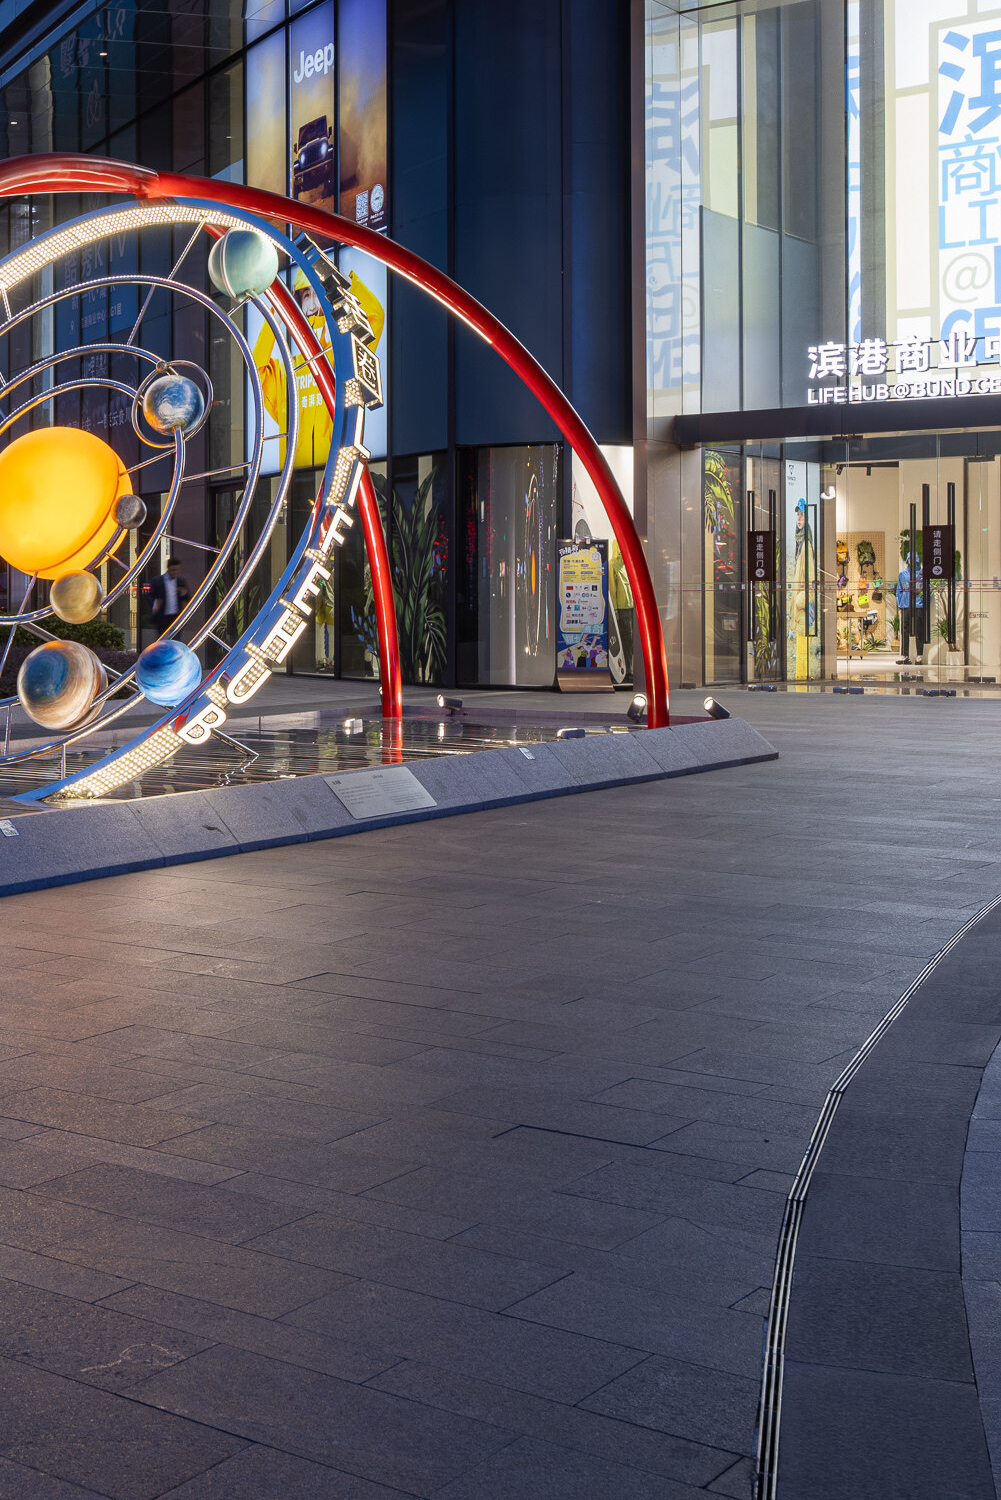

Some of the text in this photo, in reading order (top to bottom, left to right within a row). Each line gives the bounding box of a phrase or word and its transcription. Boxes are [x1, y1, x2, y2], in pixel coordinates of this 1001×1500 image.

[293, 42, 335, 84] Jeep
[938, 133, 1001, 202] 商
[807, 386, 846, 405] LIFE
[849, 383, 890, 402] HUB
[292, 405, 371, 617] LIFE
[177, 608, 308, 745] HUB
